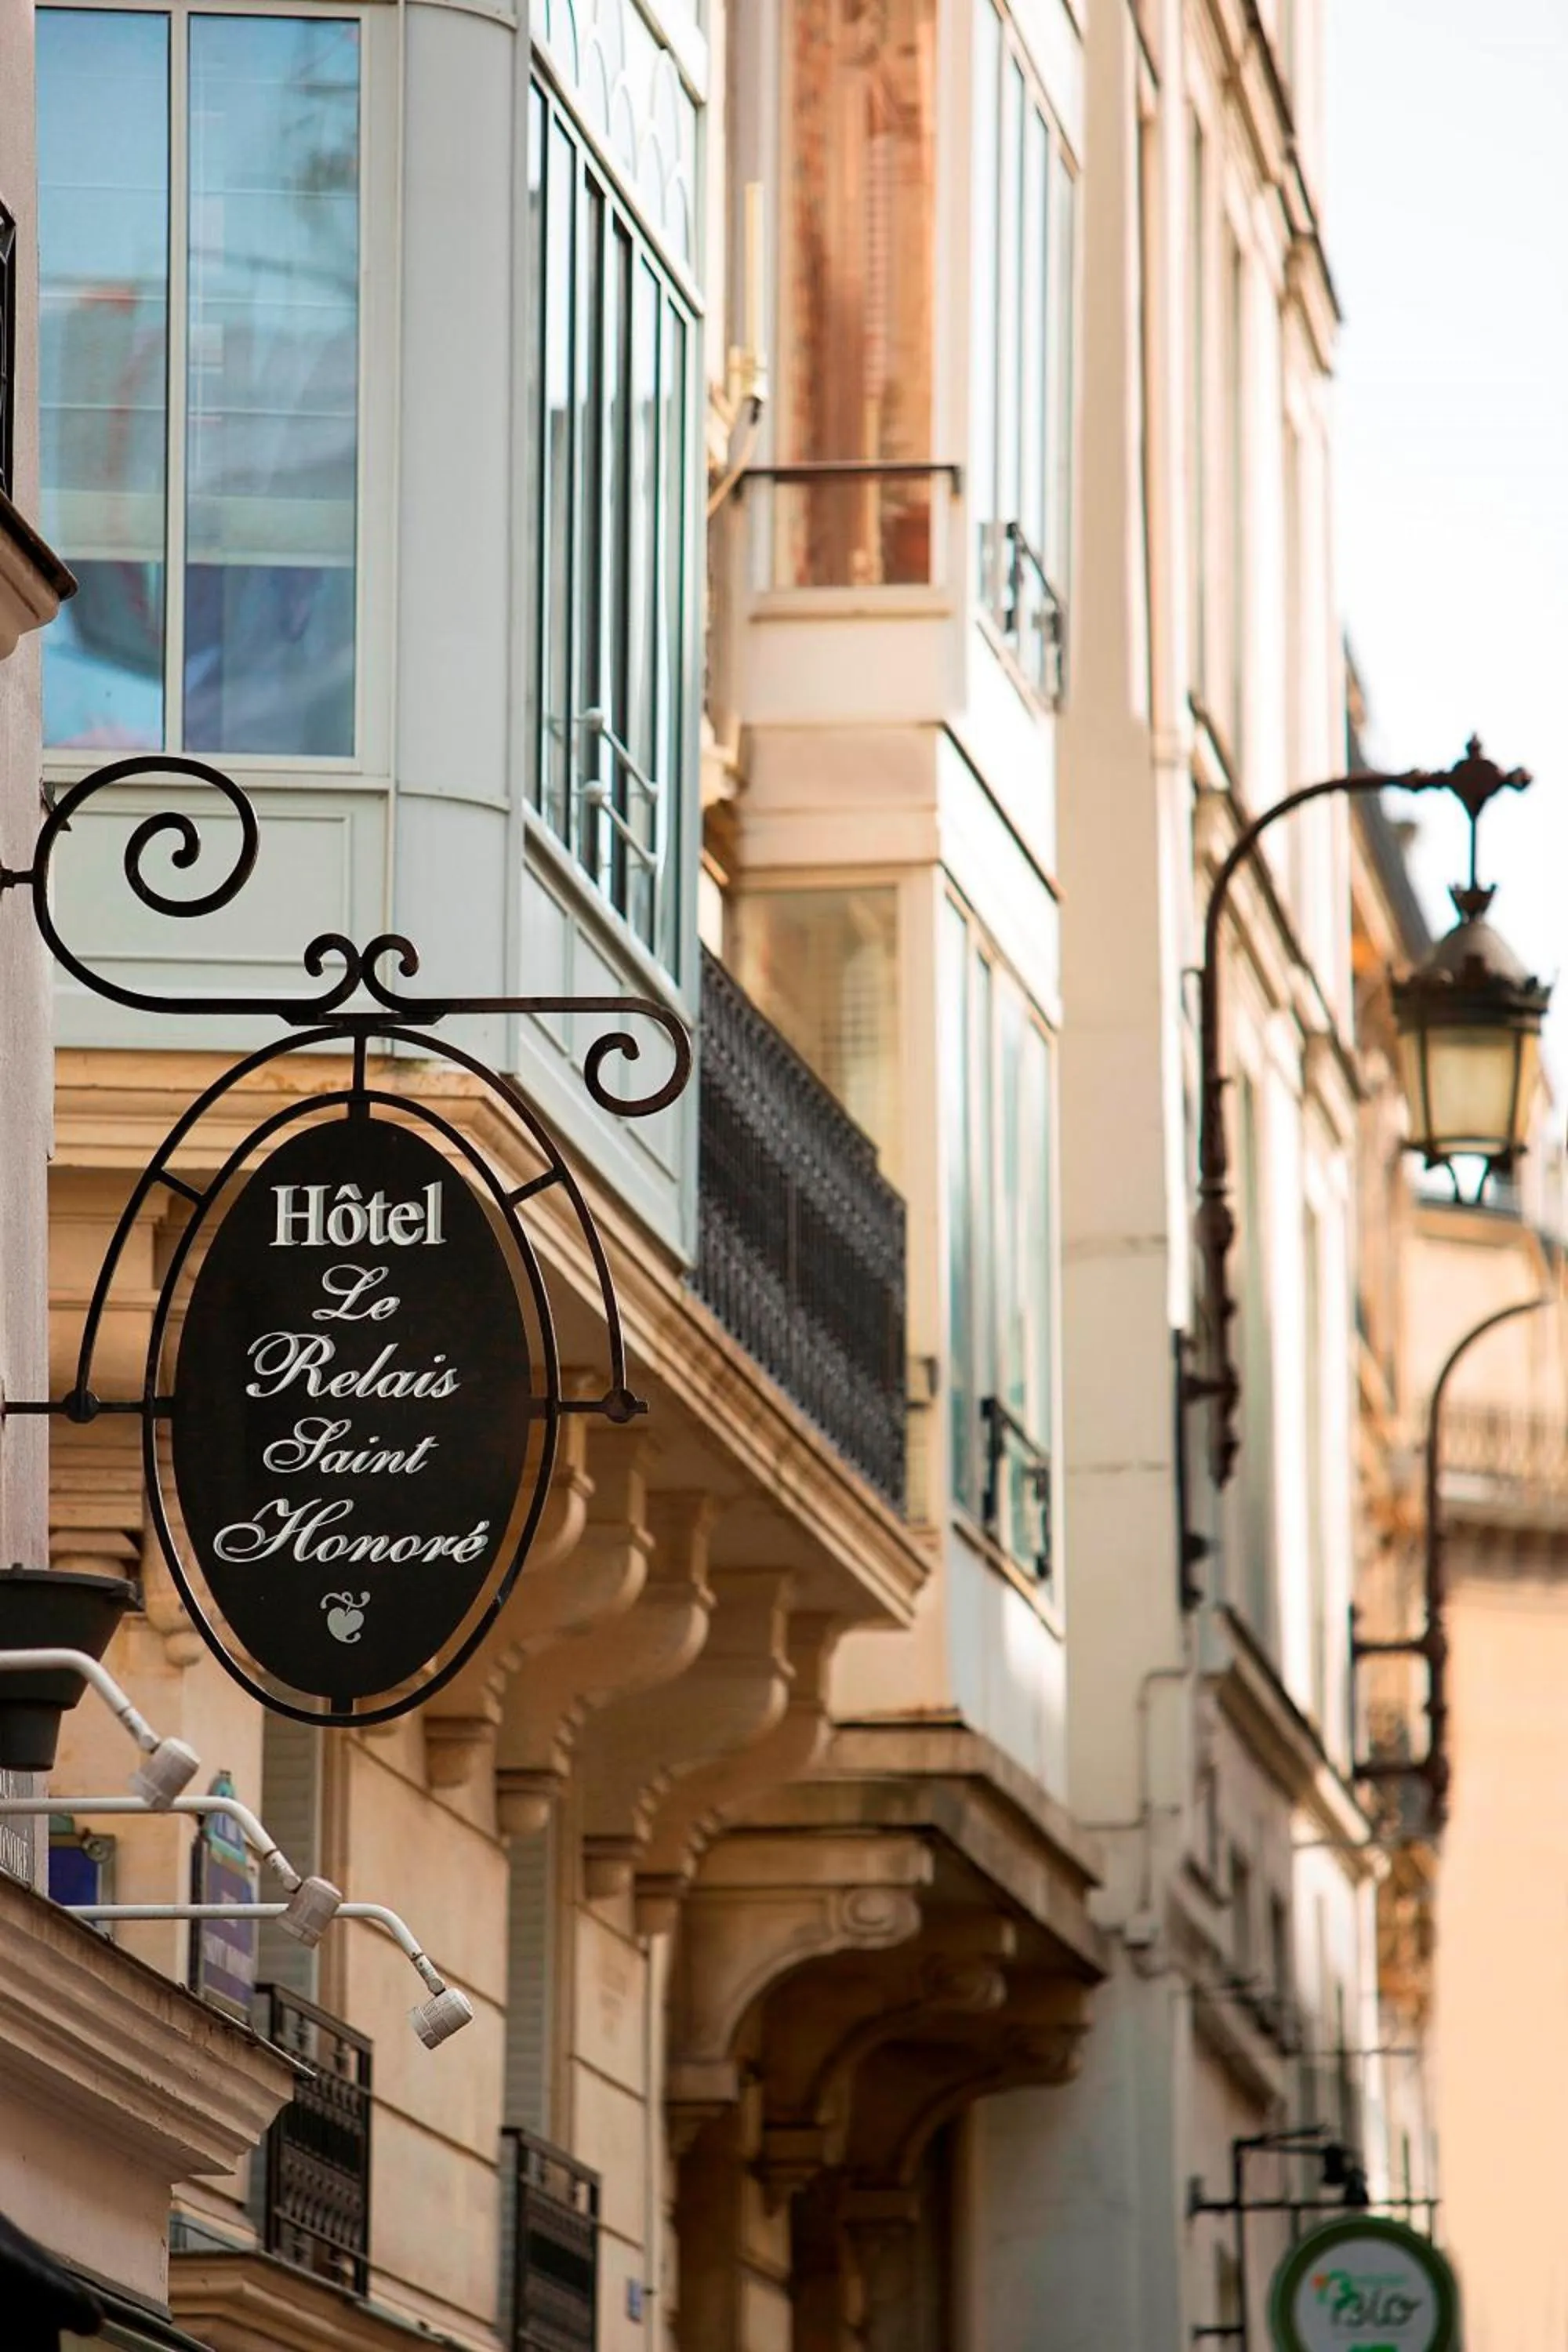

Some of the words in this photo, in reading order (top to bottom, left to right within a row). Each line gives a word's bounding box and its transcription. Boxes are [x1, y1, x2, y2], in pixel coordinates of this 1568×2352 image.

[268, 1181, 448, 1247] Hôtel
[311, 1264, 401, 1321] Le
[245, 1331, 461, 1399] Relais
[263, 1417, 439, 1474] Saint
[212, 1498, 490, 1563] Honoré
